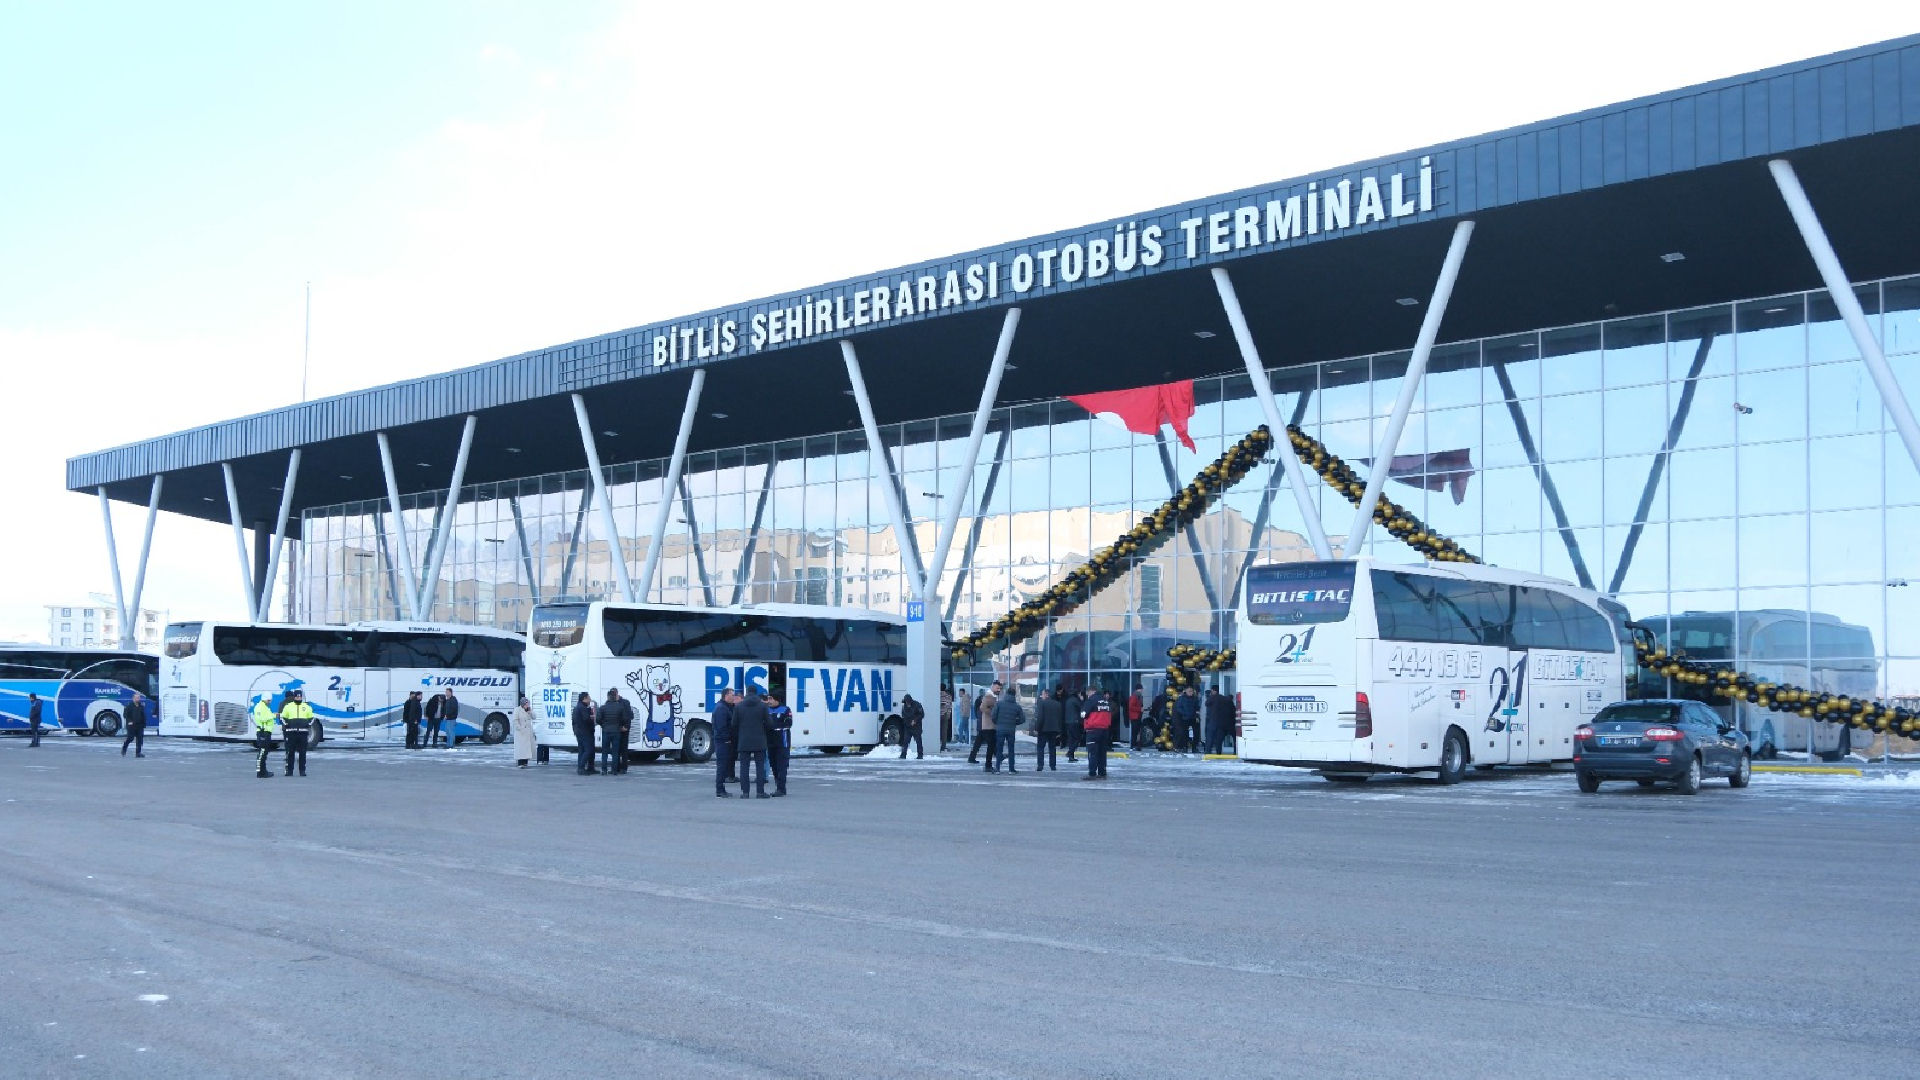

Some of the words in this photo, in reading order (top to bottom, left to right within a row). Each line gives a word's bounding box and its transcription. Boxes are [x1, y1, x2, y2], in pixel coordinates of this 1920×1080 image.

[653, 316, 738, 367] BİTLİS
[750, 261, 1000, 350] ŞEHİRLERARASI
[1011, 223, 1163, 293] OTOBÜS
[1181, 156, 1433, 260] TERMİNALİ
[1388, 646, 1433, 677] 444
[435, 676, 514, 687] VANGÖLÜ
[820, 668, 893, 713] VAN
[543, 688, 569, 702] BEST
[546, 704, 566, 718] VAN
